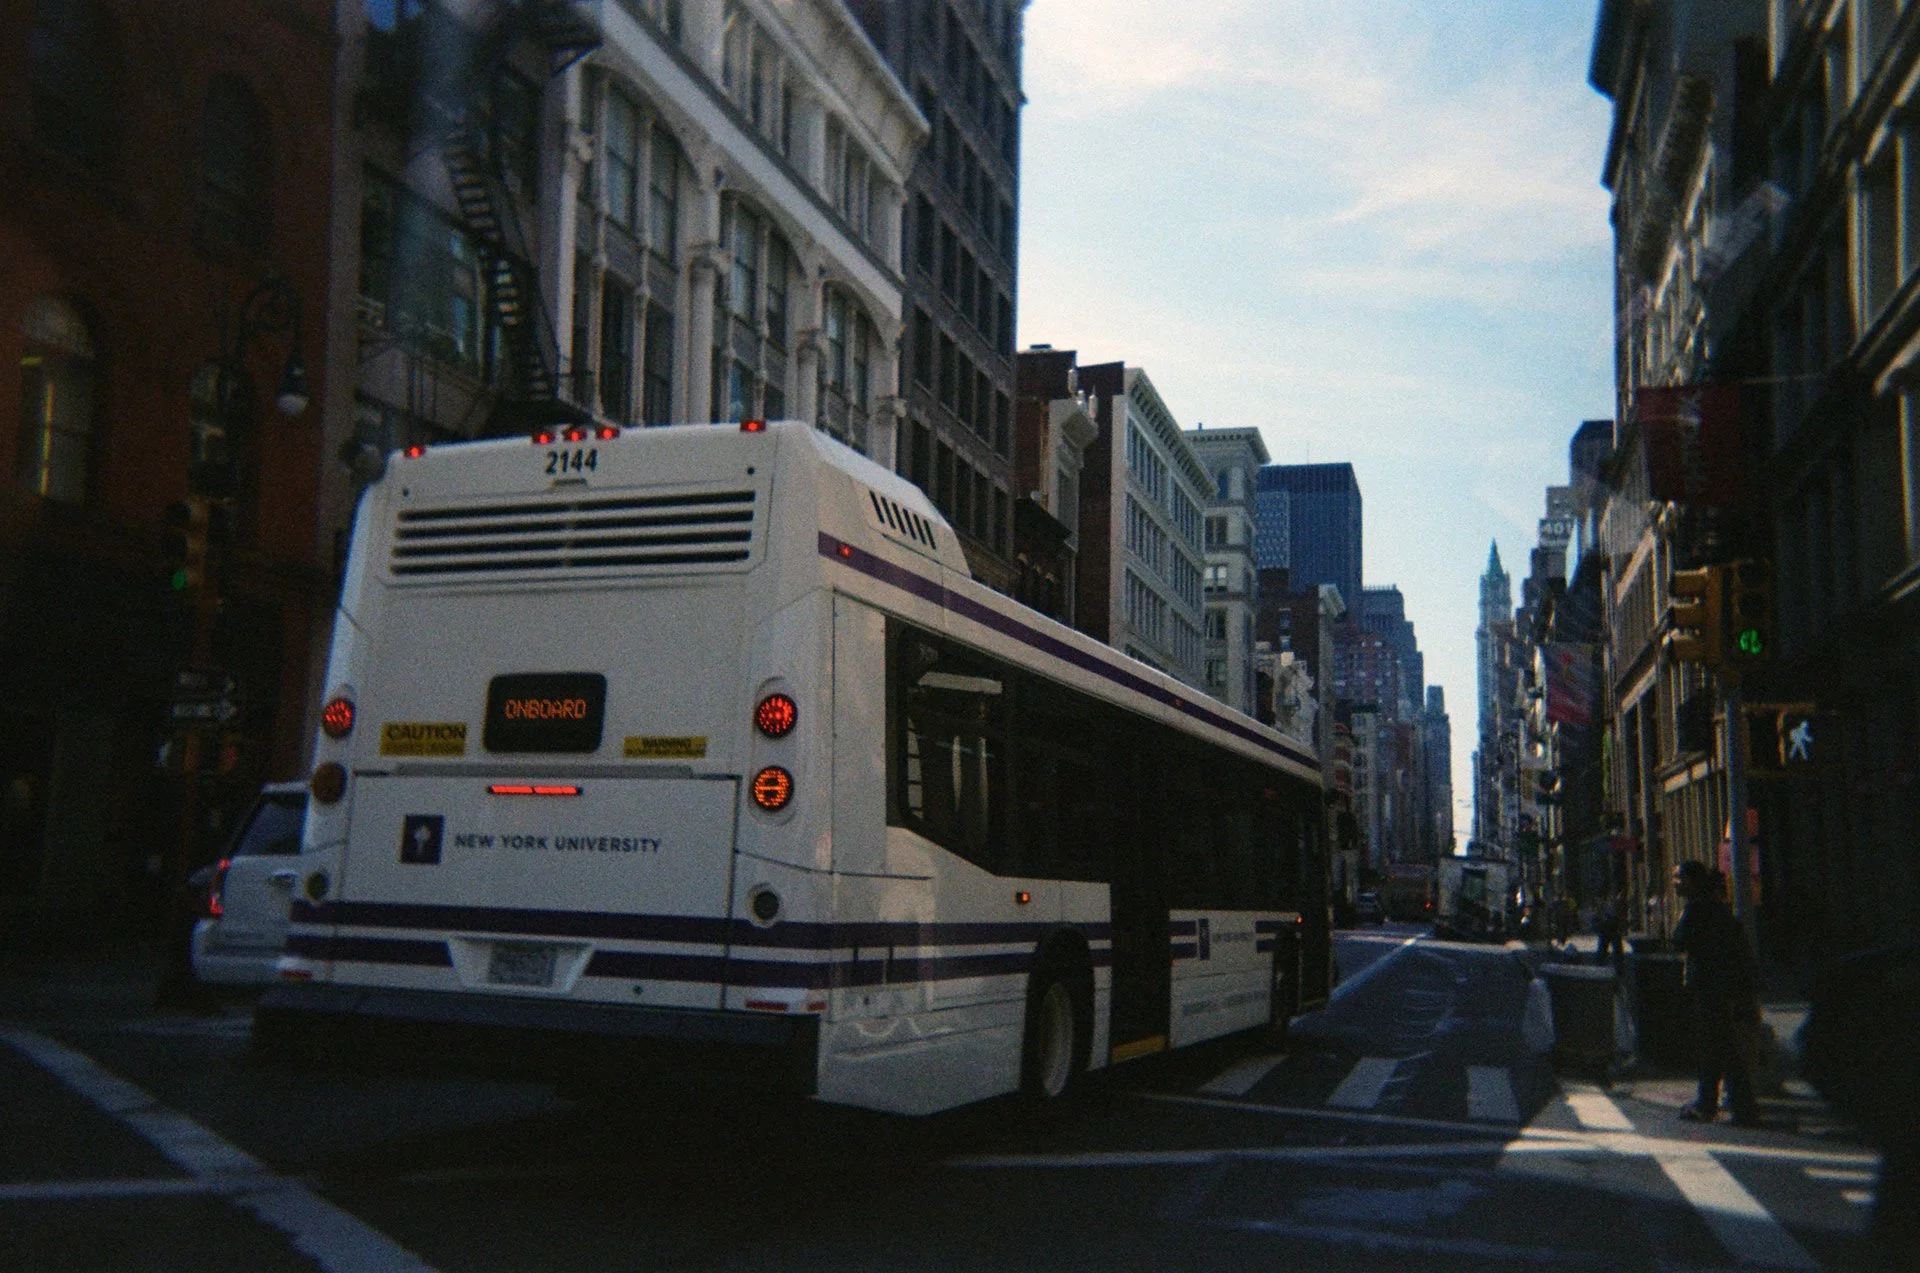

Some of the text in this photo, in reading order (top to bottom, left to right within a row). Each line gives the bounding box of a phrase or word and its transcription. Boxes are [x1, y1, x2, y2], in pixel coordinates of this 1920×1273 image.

[545, 449, 597, 475] 2144
[503, 697, 587, 720] ONBOARD
[386, 724, 466, 740] CAUTION
[454, 833, 662, 853] NEW YORK UNIVERSITY
